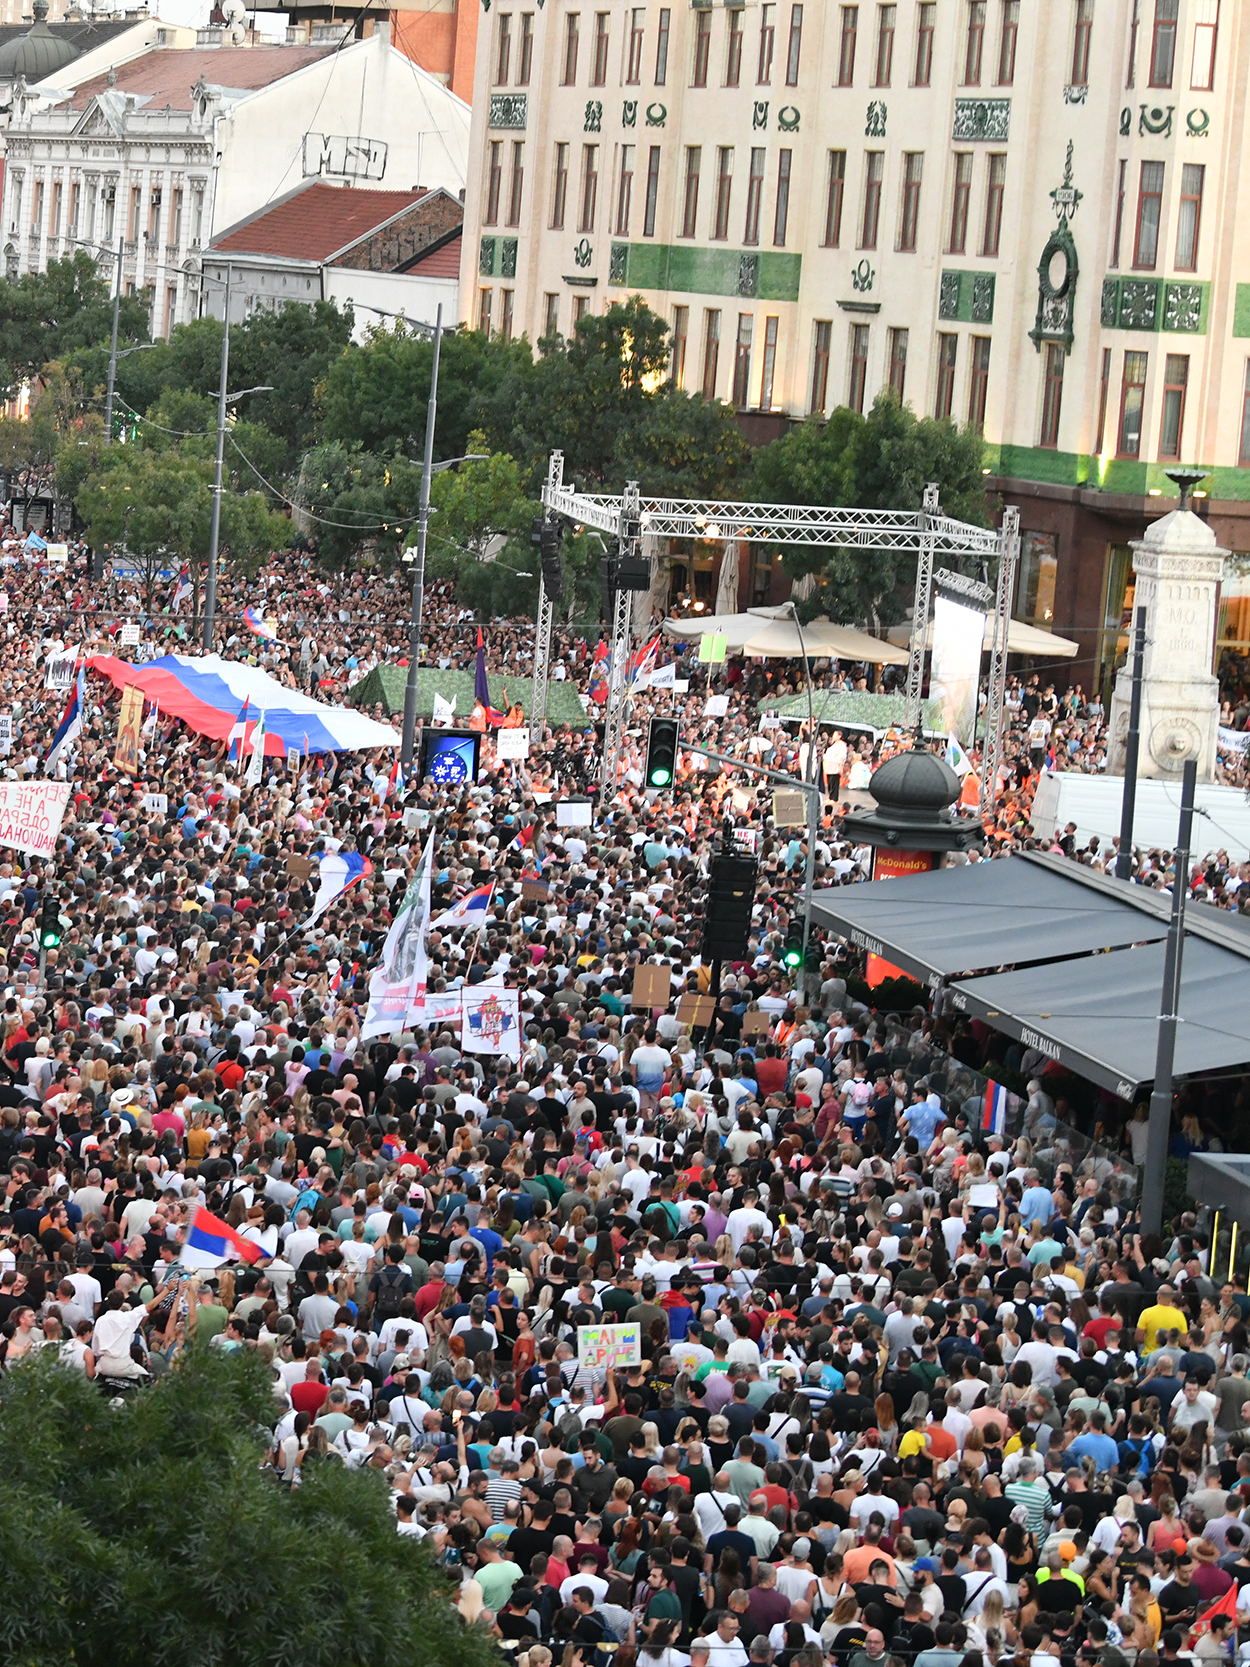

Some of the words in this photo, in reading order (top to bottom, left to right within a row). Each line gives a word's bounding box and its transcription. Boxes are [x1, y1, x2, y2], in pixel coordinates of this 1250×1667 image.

[1057, 191, 1074, 200] 1906
[877, 856, 928, 870] McDonald's
[851, 929, 866, 946] HOTEL
[864, 937, 883, 956] BALKAN
[1021, 1027, 1039, 1049] HOTEL
[1039, 1038, 1061, 1060] BALKAN
[584, 1346, 636, 1367] ДРИНЕ
